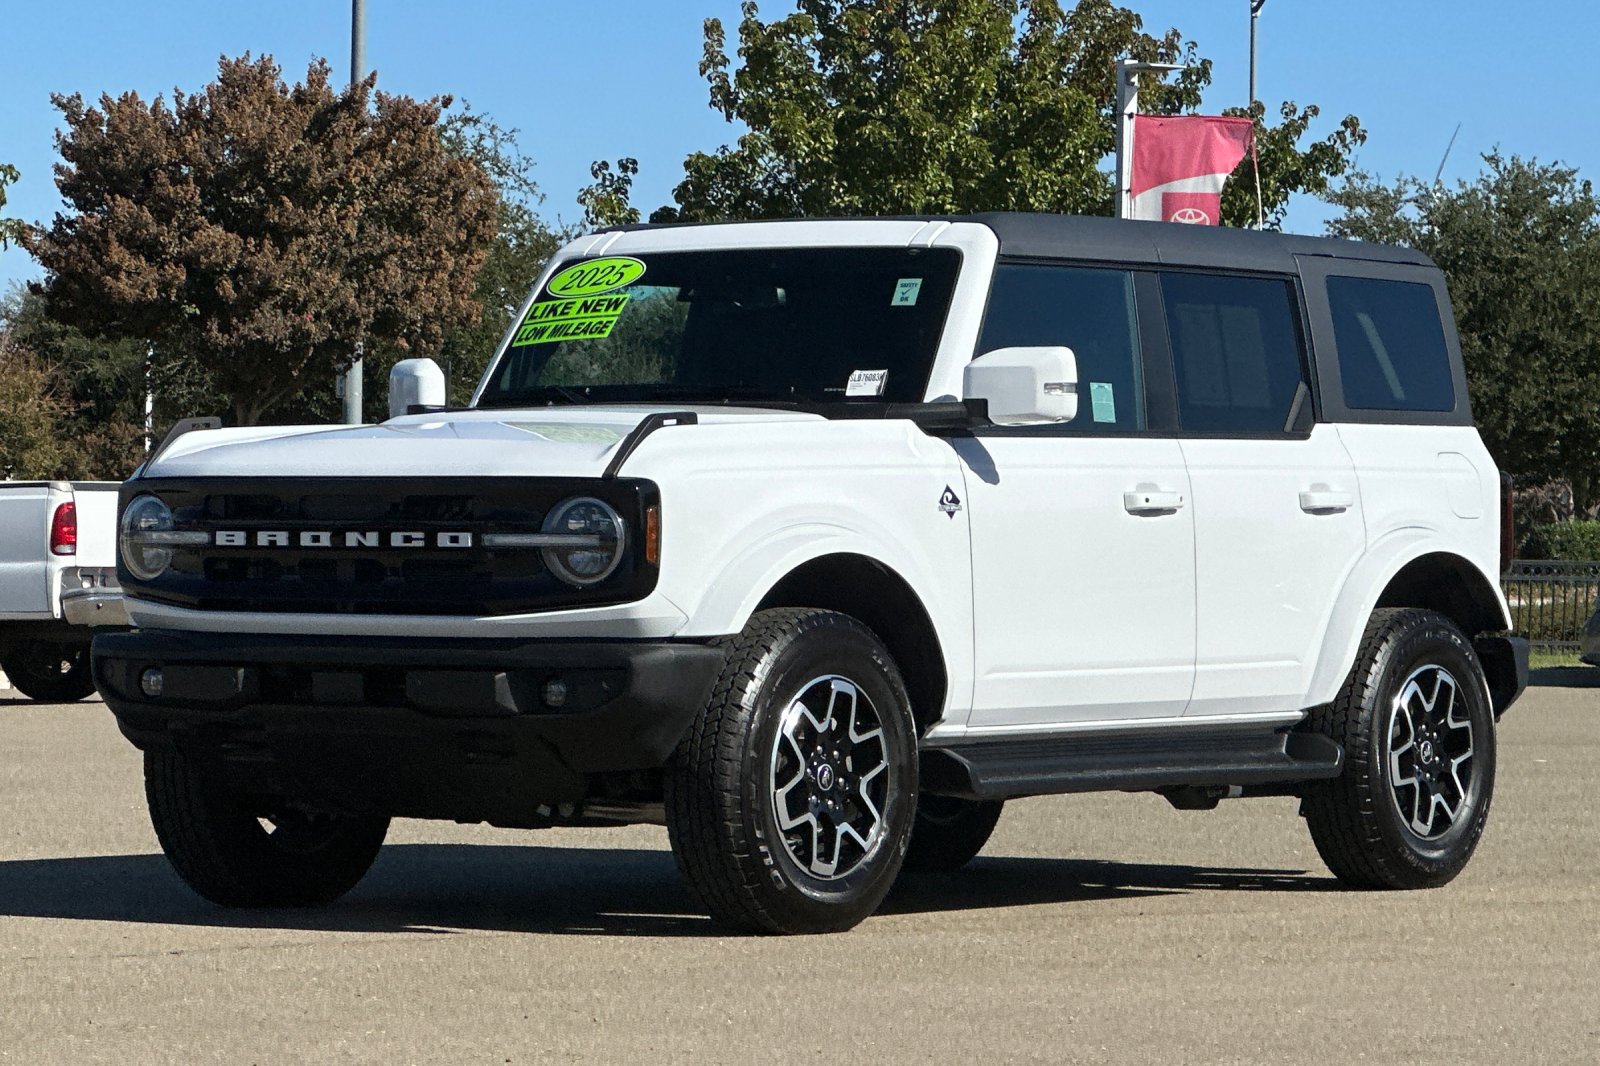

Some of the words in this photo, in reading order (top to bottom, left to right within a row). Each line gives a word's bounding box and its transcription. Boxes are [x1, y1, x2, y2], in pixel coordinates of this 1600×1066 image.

[559, 263, 633, 292] 2025
[528, 300, 577, 320] LIKE
[576, 297, 627, 315] NEW
[515, 324, 551, 343] LOW
[546, 320, 614, 340] MILEAGE
[215, 530, 473, 547] BRONCO
